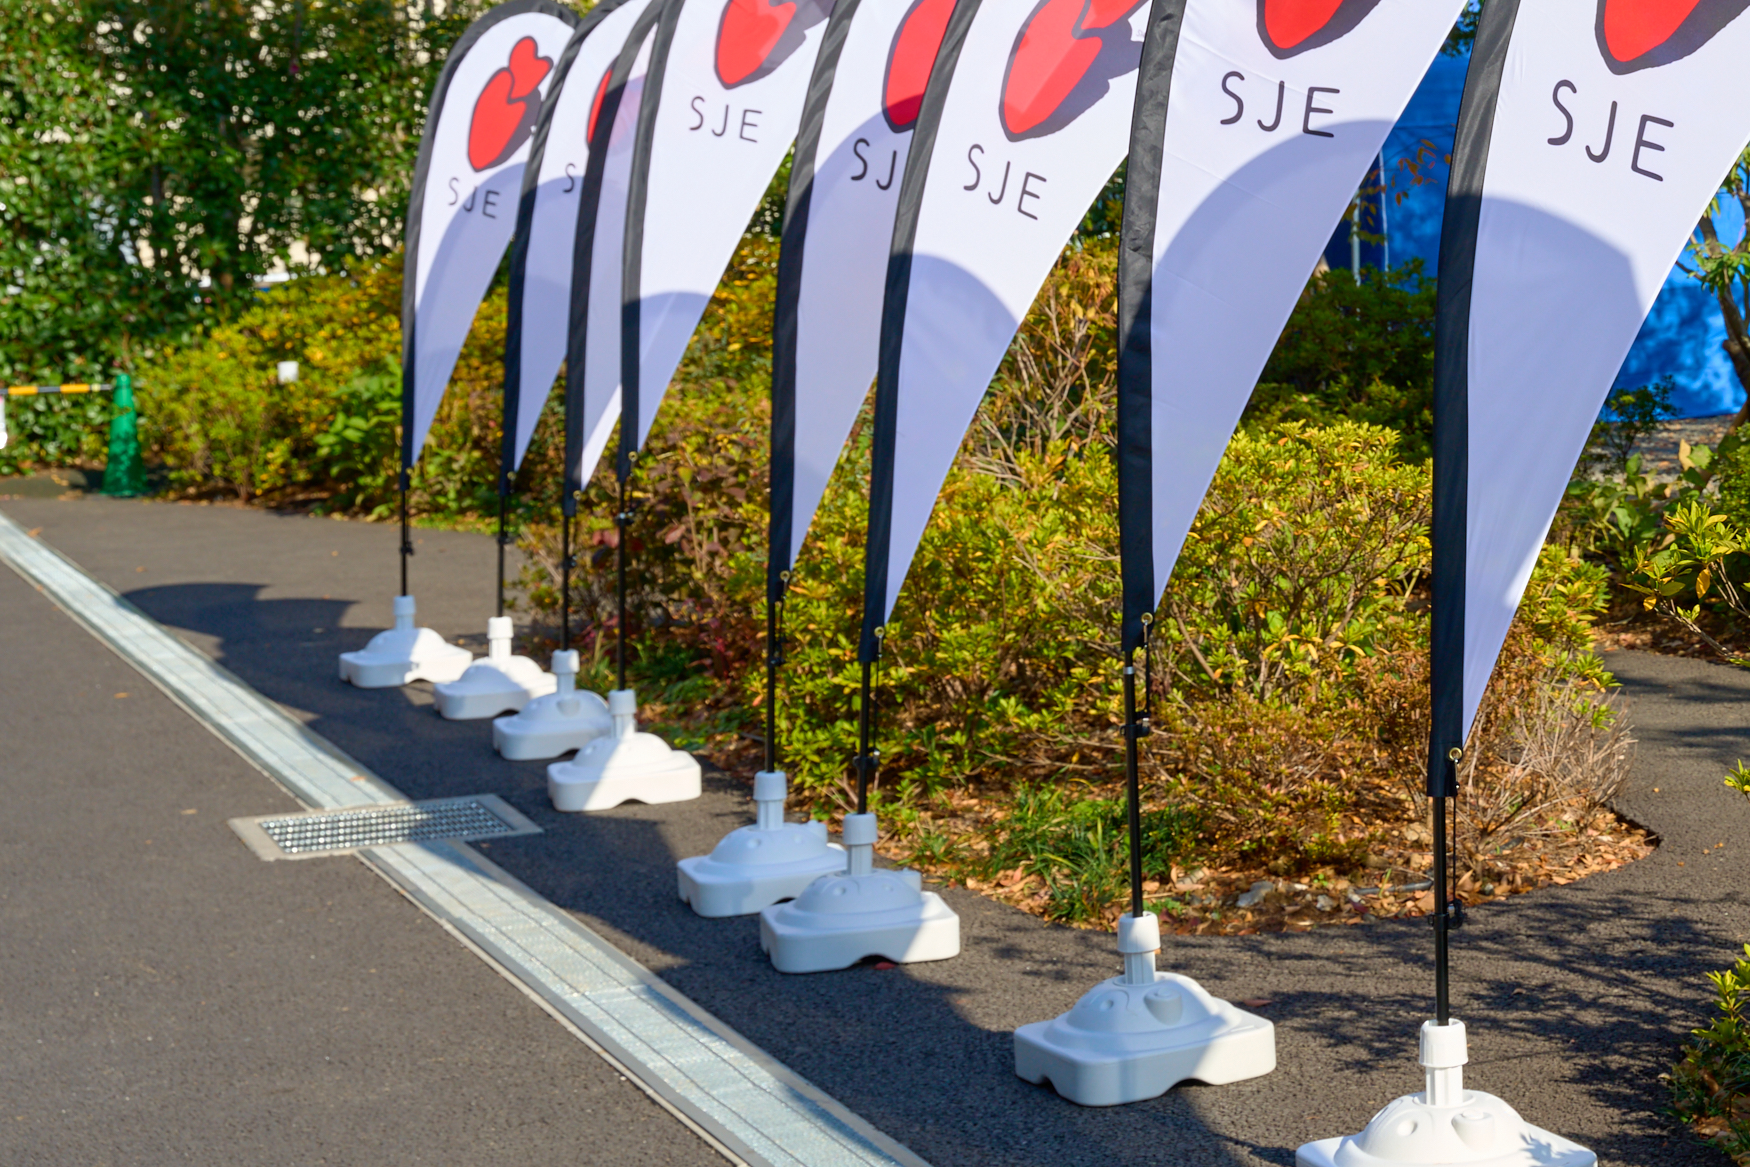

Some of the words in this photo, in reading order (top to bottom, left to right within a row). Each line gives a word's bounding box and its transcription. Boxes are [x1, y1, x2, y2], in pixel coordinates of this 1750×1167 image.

[689, 95, 763, 144] SJE
[1219, 70, 1340, 137] SJE
[1546, 78, 1675, 183] SJE
[850, 137, 898, 192] SJ
[962, 143, 1048, 221] SJE
[448, 176, 501, 220] SJE
